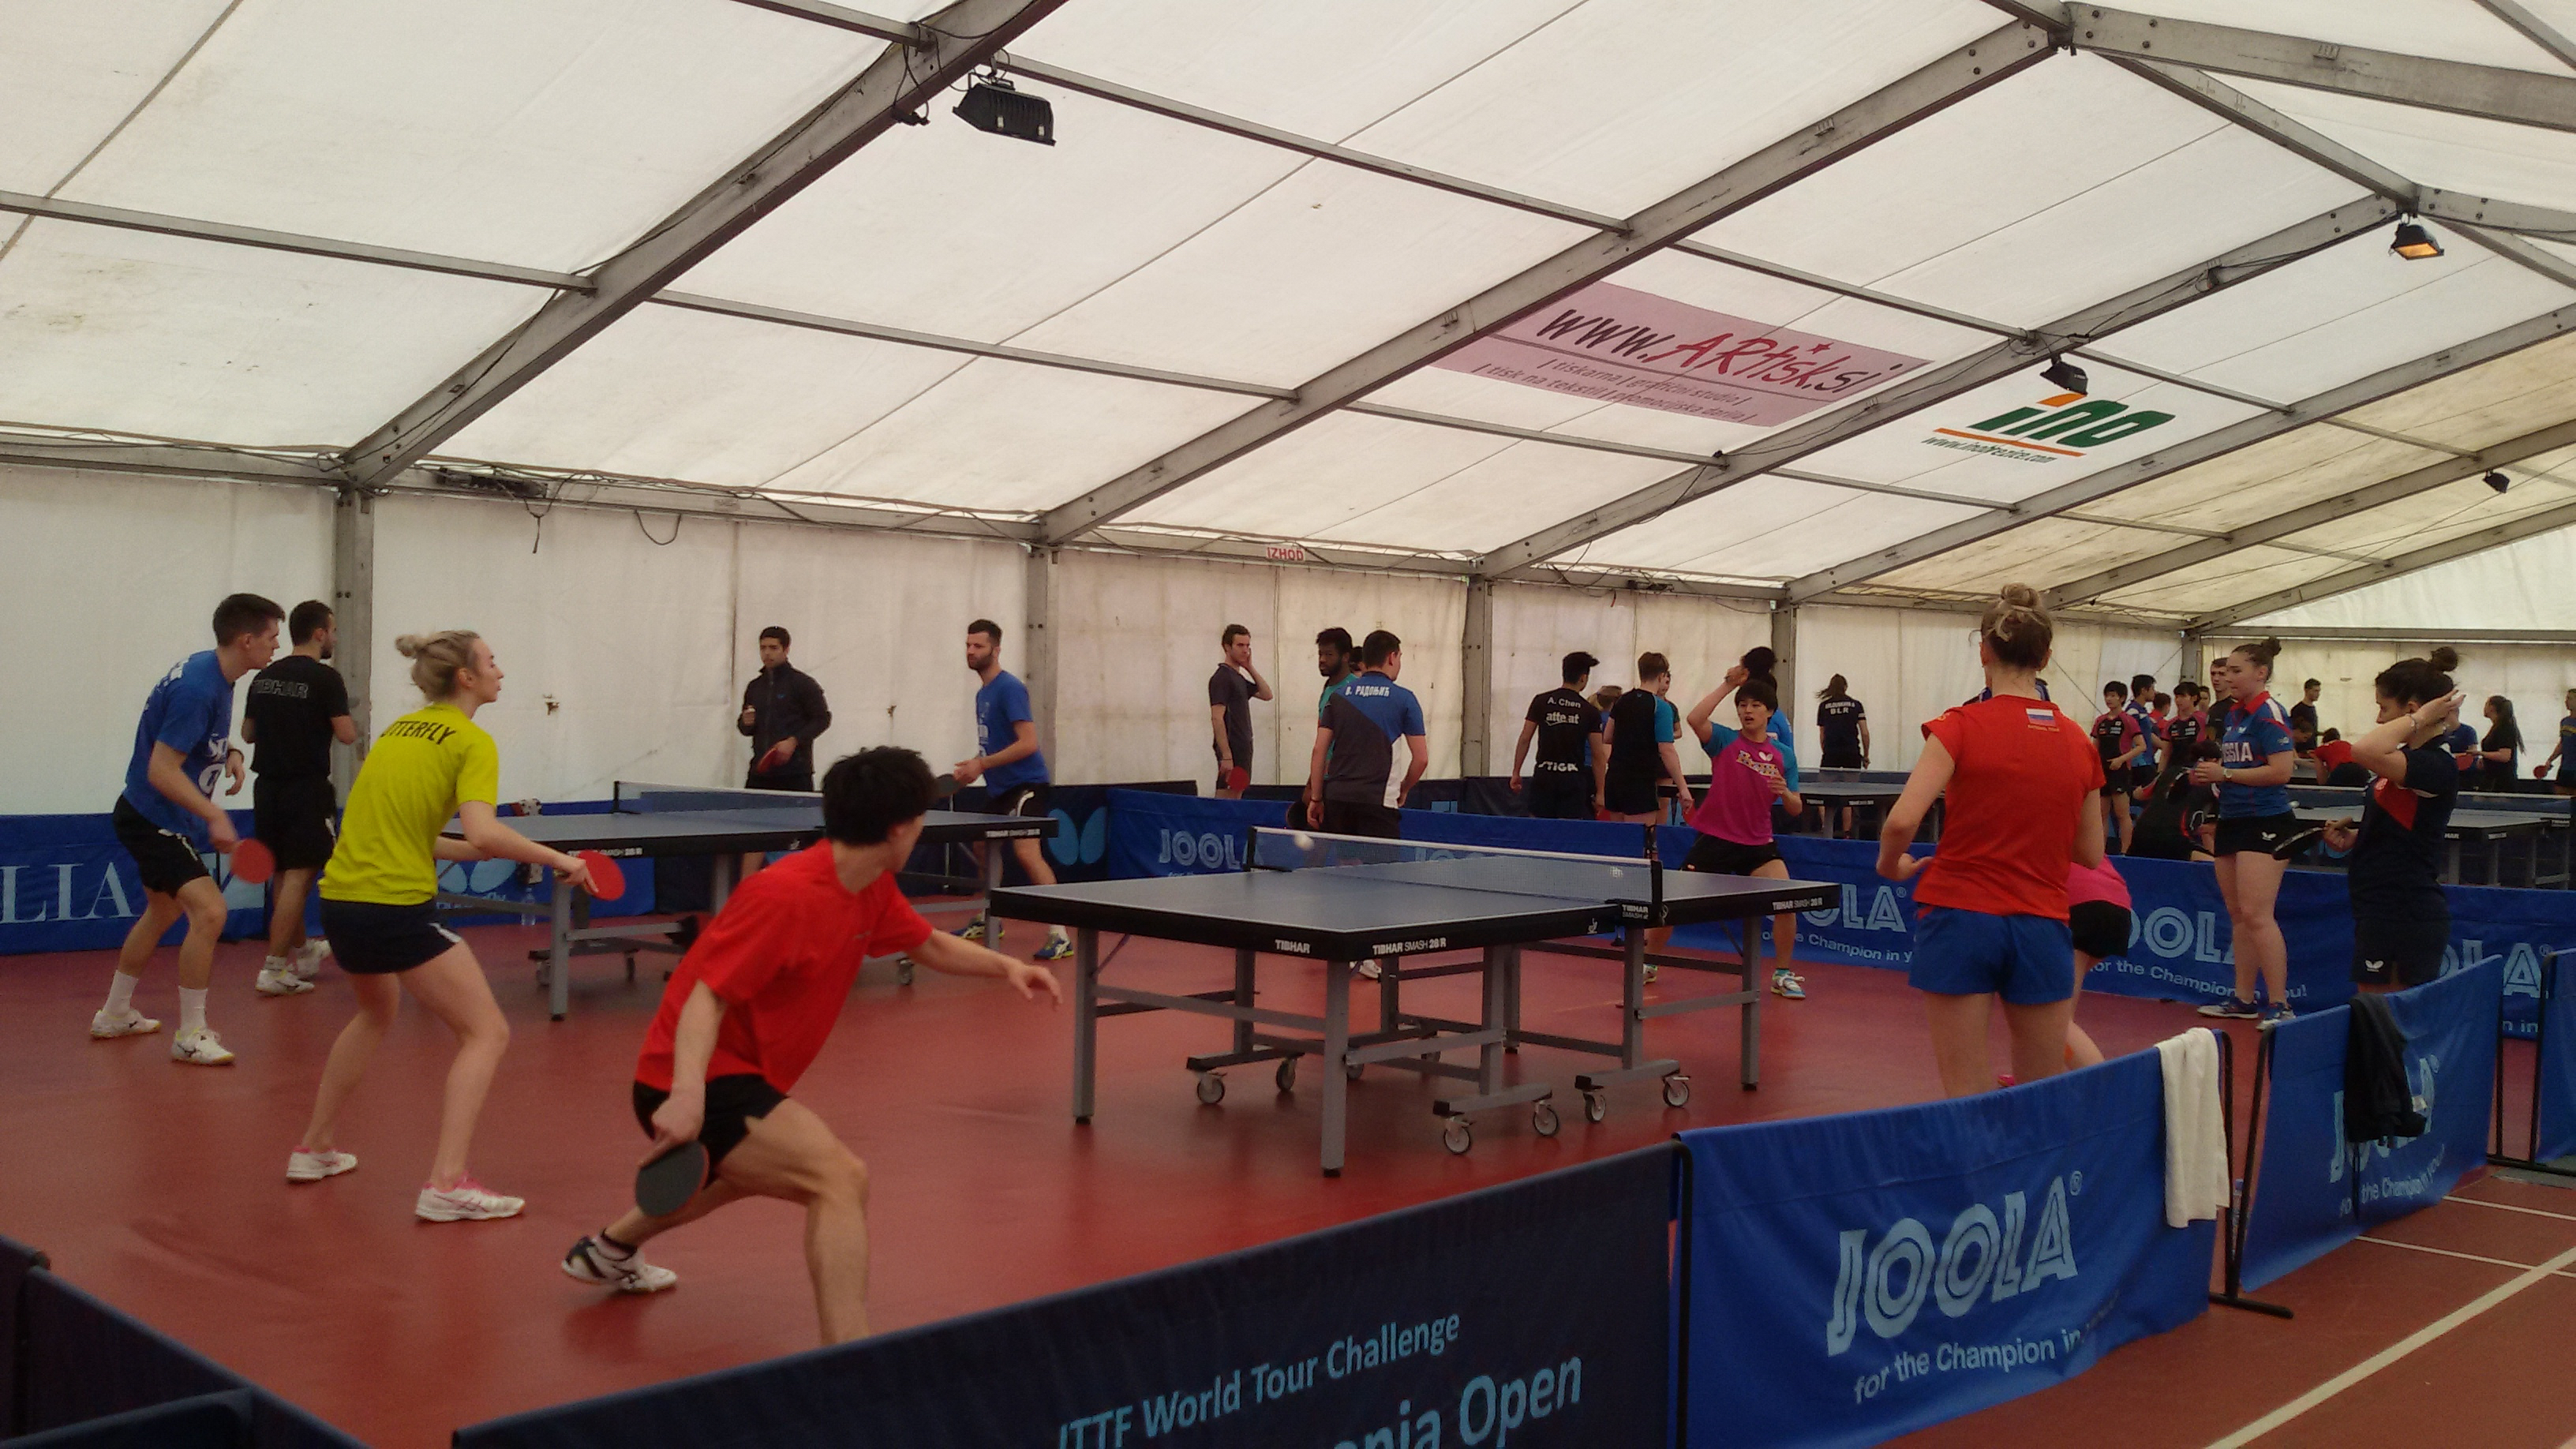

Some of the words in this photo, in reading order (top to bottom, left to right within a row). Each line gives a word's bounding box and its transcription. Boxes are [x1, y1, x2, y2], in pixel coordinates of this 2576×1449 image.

[1525, 374, 1548, 385] na
[1267, 547, 1304, 560] IZHOD
[1559, 698, 1581, 708] Chen
[380, 721, 456, 745] UTTERFLY
[1538, 762, 1578, 772] STIGA
[1622, 904, 1649, 914] TIBHAR
[1275, 938, 1310, 954] TIBHAR
[1372, 942, 1403, 956] TIBHAR
[1404, 939, 1428, 952] SMASH
[1808, 933, 1883, 960] Champion
[1886, 949, 1900, 961] in
[2117, 960, 2145, 975] the
[2285, 984, 2308, 999] ou!
[1825, 1175, 2079, 1357] JOOLA
[1853, 1367, 1890, 1404] for
[1894, 1350, 1930, 1382] the
[1937, 1337, 2055, 1373] Champion
[1058, 1406, 1133, 1449] ITTF
[1143, 1366, 1241, 1438] World
[1250, 1356, 1320, 1404] Tour
[1327, 1312, 1461, 1380] Challenge
[1458, 1354, 1583, 1449] Open
